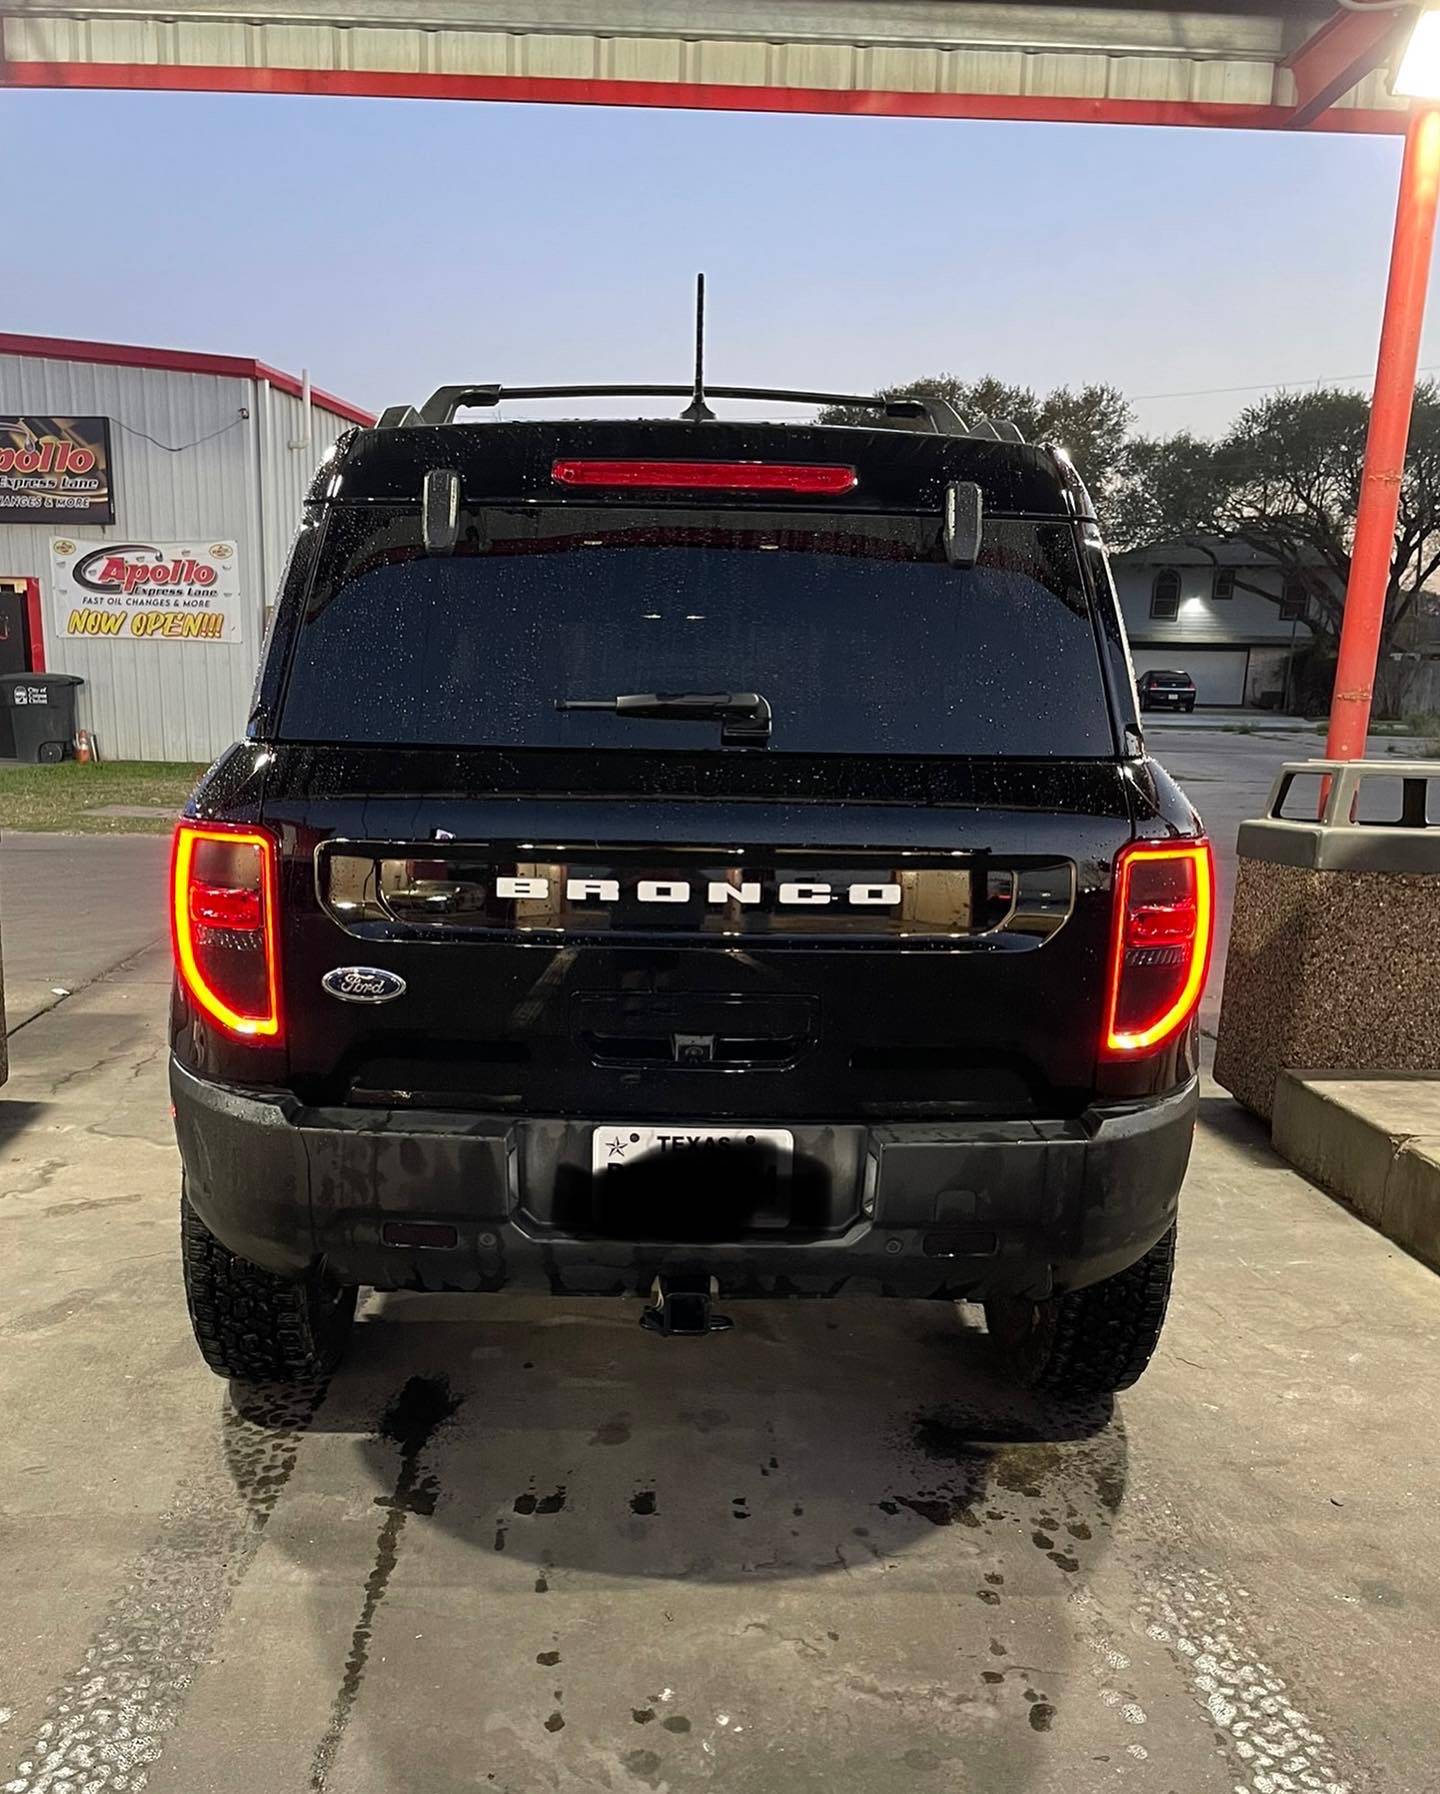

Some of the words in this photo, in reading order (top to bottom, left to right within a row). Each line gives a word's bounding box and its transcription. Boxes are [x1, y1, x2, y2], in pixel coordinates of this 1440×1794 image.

[60, 476, 98, 489] Lane
[44, 497, 53, 508] &
[55, 496, 90, 508] MORE
[98, 556, 216, 593] Apollo
[134, 586, 183, 597] Express
[187, 588, 218, 597] Lane
[82, 596, 104, 605] FAST
[107, 597, 122, 606] OIL
[125, 598, 170, 607] CHANGES
[173, 599, 179, 607] &
[182, 600, 210, 608] MORE
[68, 608, 128, 635] NOW
[131, 610, 224, 638] OPEN!!!
[496, 876, 902, 905] BRONCO
[341, 973, 385, 994] Ford
[657, 1135, 731, 1152] TEXAS
